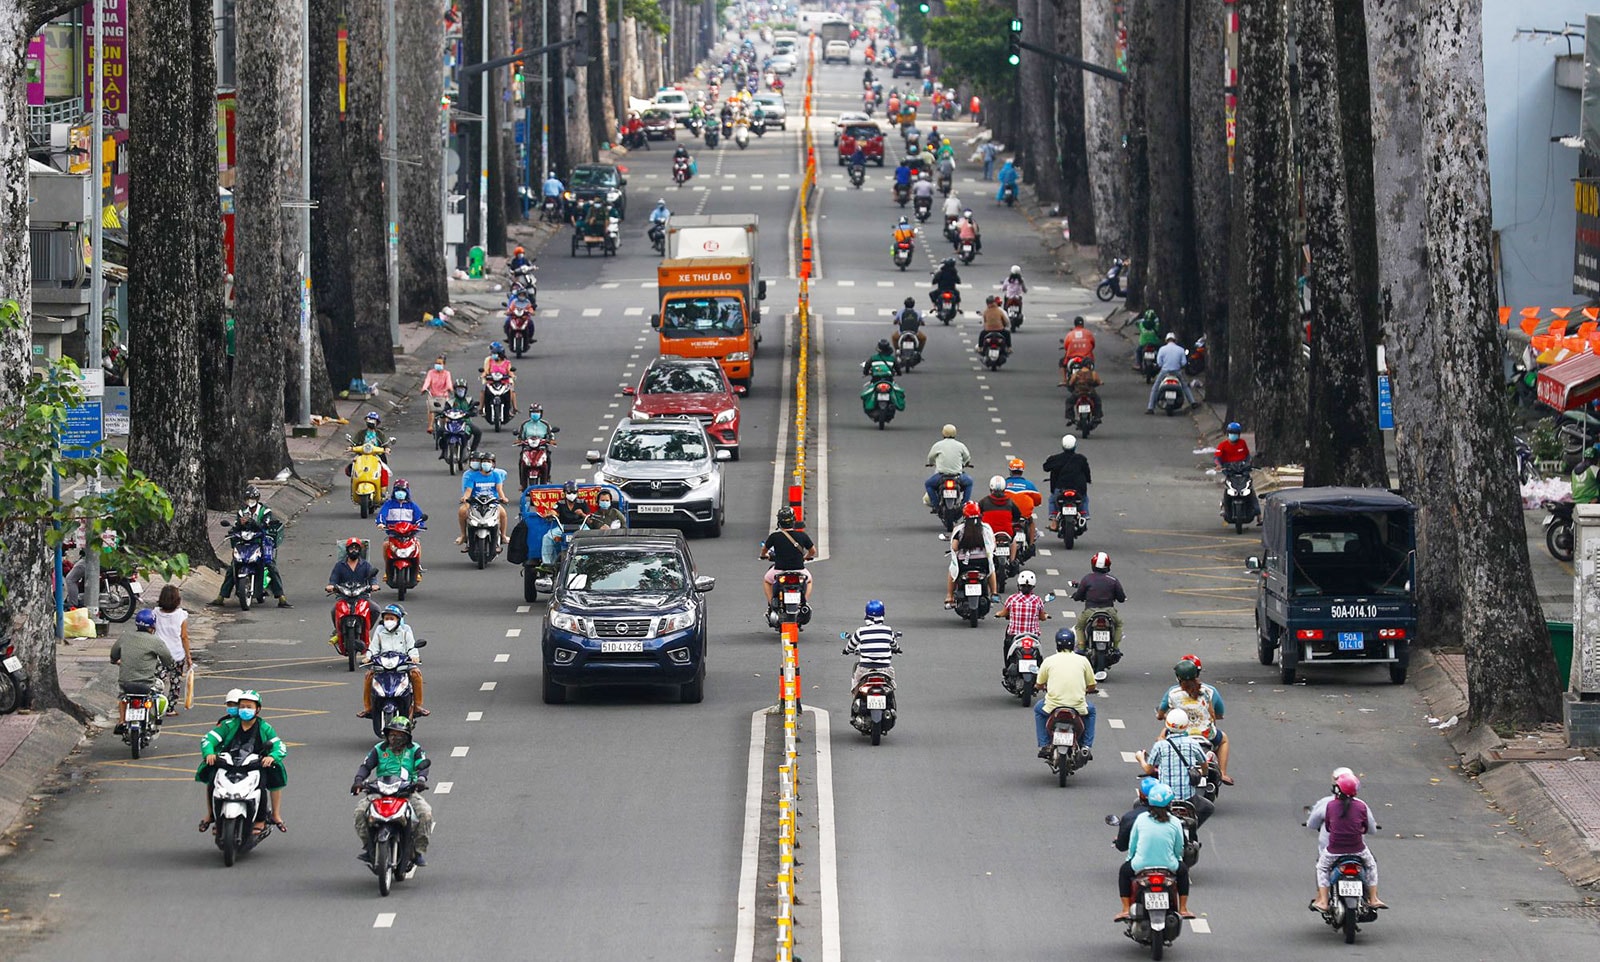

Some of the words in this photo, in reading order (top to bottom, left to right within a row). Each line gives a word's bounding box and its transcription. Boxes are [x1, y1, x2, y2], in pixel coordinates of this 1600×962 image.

[87, 26, 124, 37] ĐNG
[679, 274, 690, 282] XE
[692, 273, 711, 281] THƯ
[712, 271, 732, 281] BÁO
[1331, 605, 1377, 618] 50A-014.10
[1344, 633, 1357, 641] 50A
